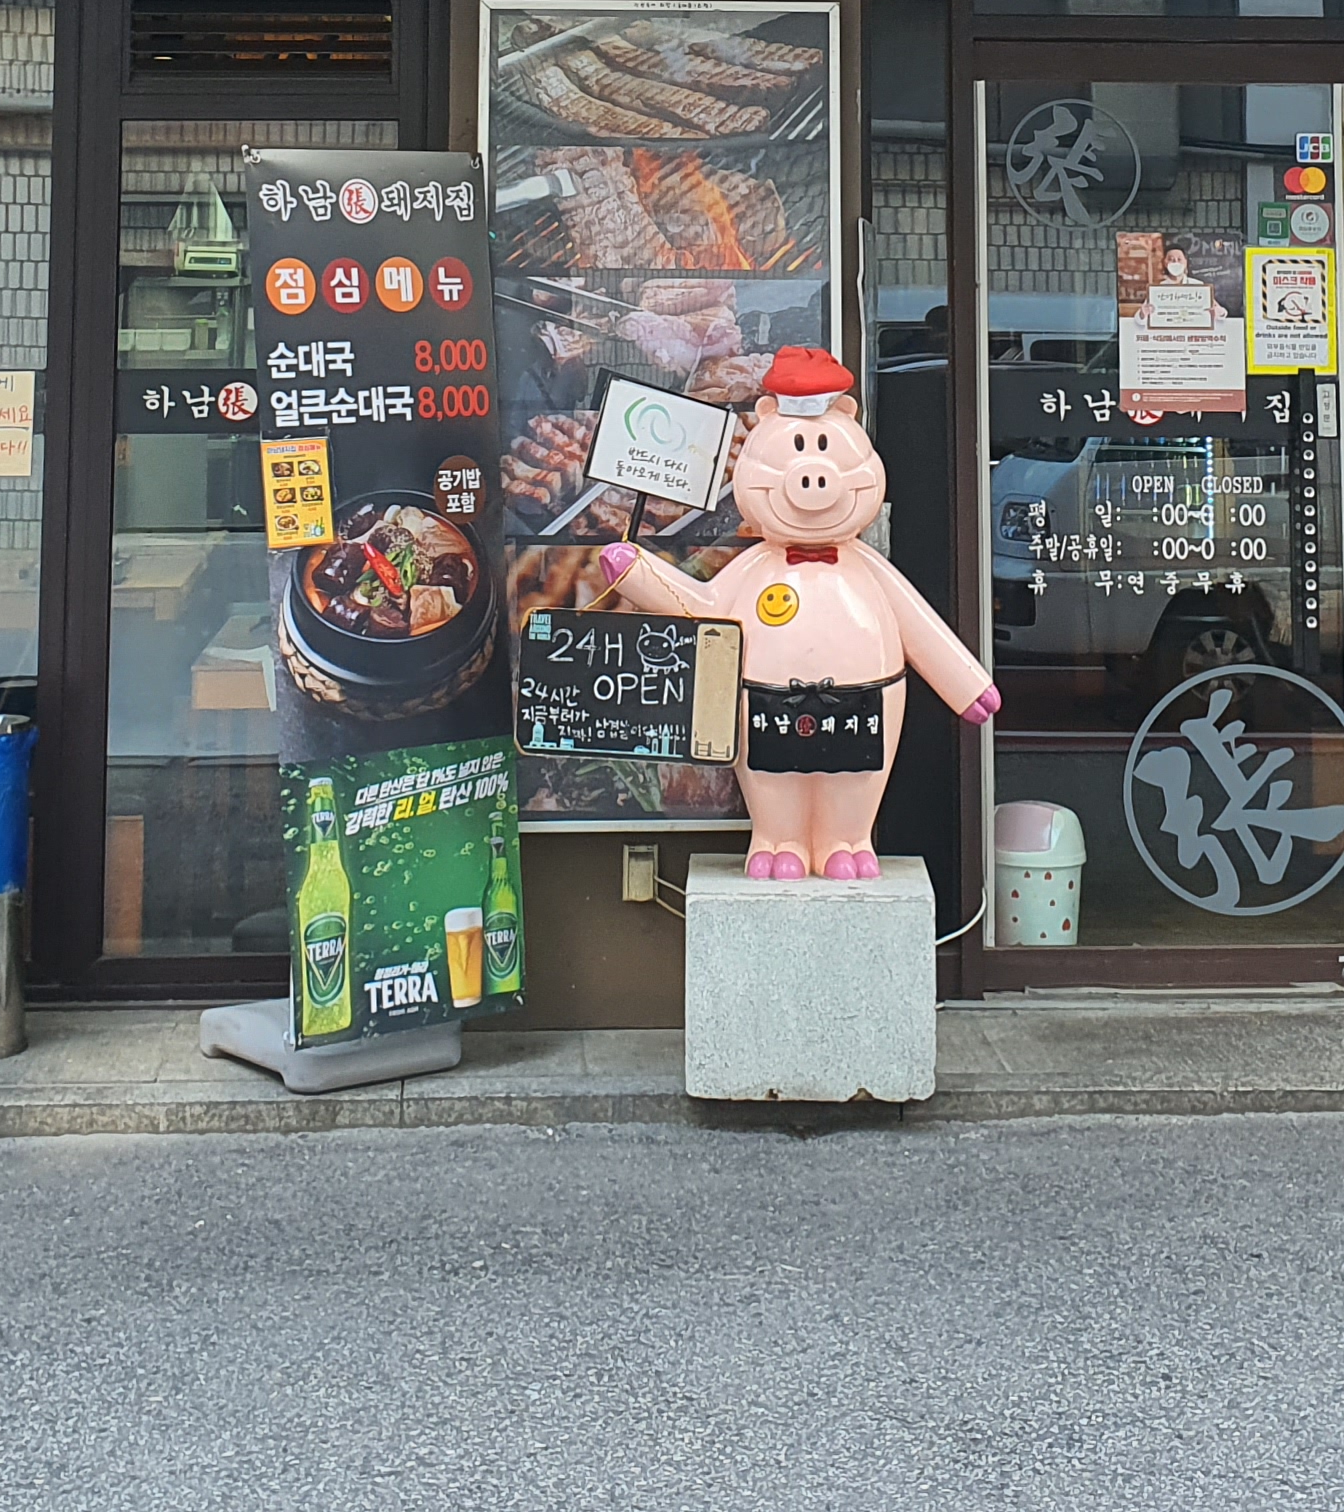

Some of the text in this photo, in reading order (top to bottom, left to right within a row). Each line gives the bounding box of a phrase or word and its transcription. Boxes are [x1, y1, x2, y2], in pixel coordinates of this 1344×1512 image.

[274, 266, 464, 305] 점심메뉴
[1273, 276, 1298, 286] 마스크
[267, 339, 487, 379] 순대국 8,000
[270, 384, 489, 428] 얼큰순대국 8,000
[616, 460, 661, 482] 돌아오게
[628, 447, 688, 473] 반드시 다시
[437, 468, 481, 492] 공기밥
[1132, 475, 1263, 494] OPEN CLOSED
[446, 492, 476, 514] 포함
[521, 677, 580, 707] 24시간
[593, 672, 684, 705] OPEN
[521, 705, 590, 725] 지금부터가
[345, 801, 394, 836] 강력한
[438, 780, 473, 811] 탄산
[474, 771, 510, 801] 100%
[484, 926, 516, 944] TERRA
[306, 937, 344, 961] TERRA
[364, 972, 439, 1014] TERRA
